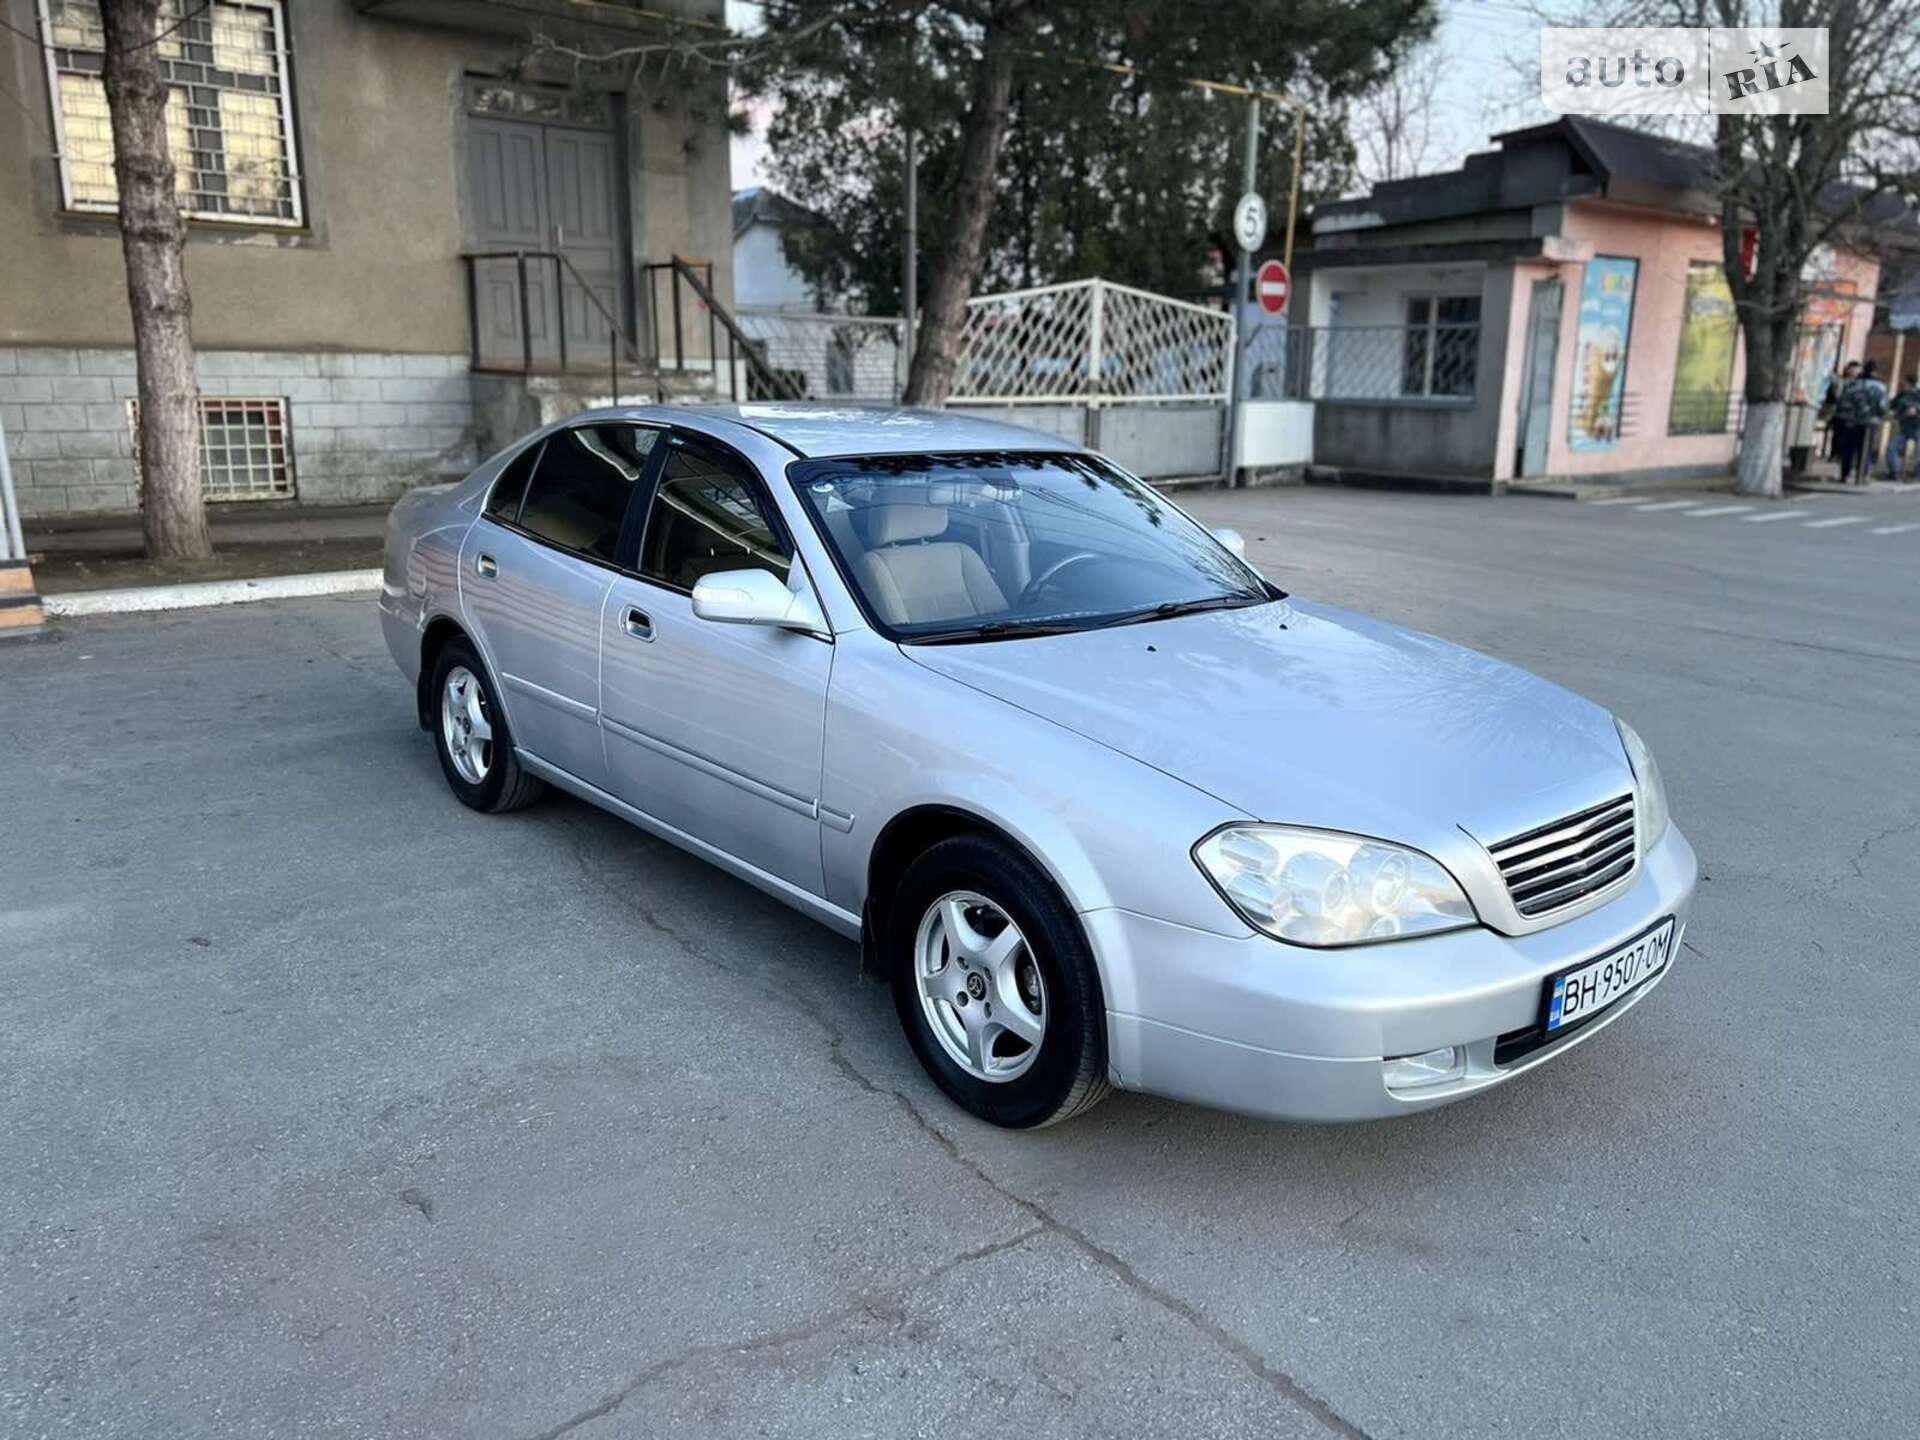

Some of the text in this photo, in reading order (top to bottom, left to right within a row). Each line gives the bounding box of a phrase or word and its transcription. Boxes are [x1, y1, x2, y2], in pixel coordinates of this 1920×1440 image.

[1244, 205, 1258, 238] 5
[1563, 928, 1669, 1016] BH 9507 OM
